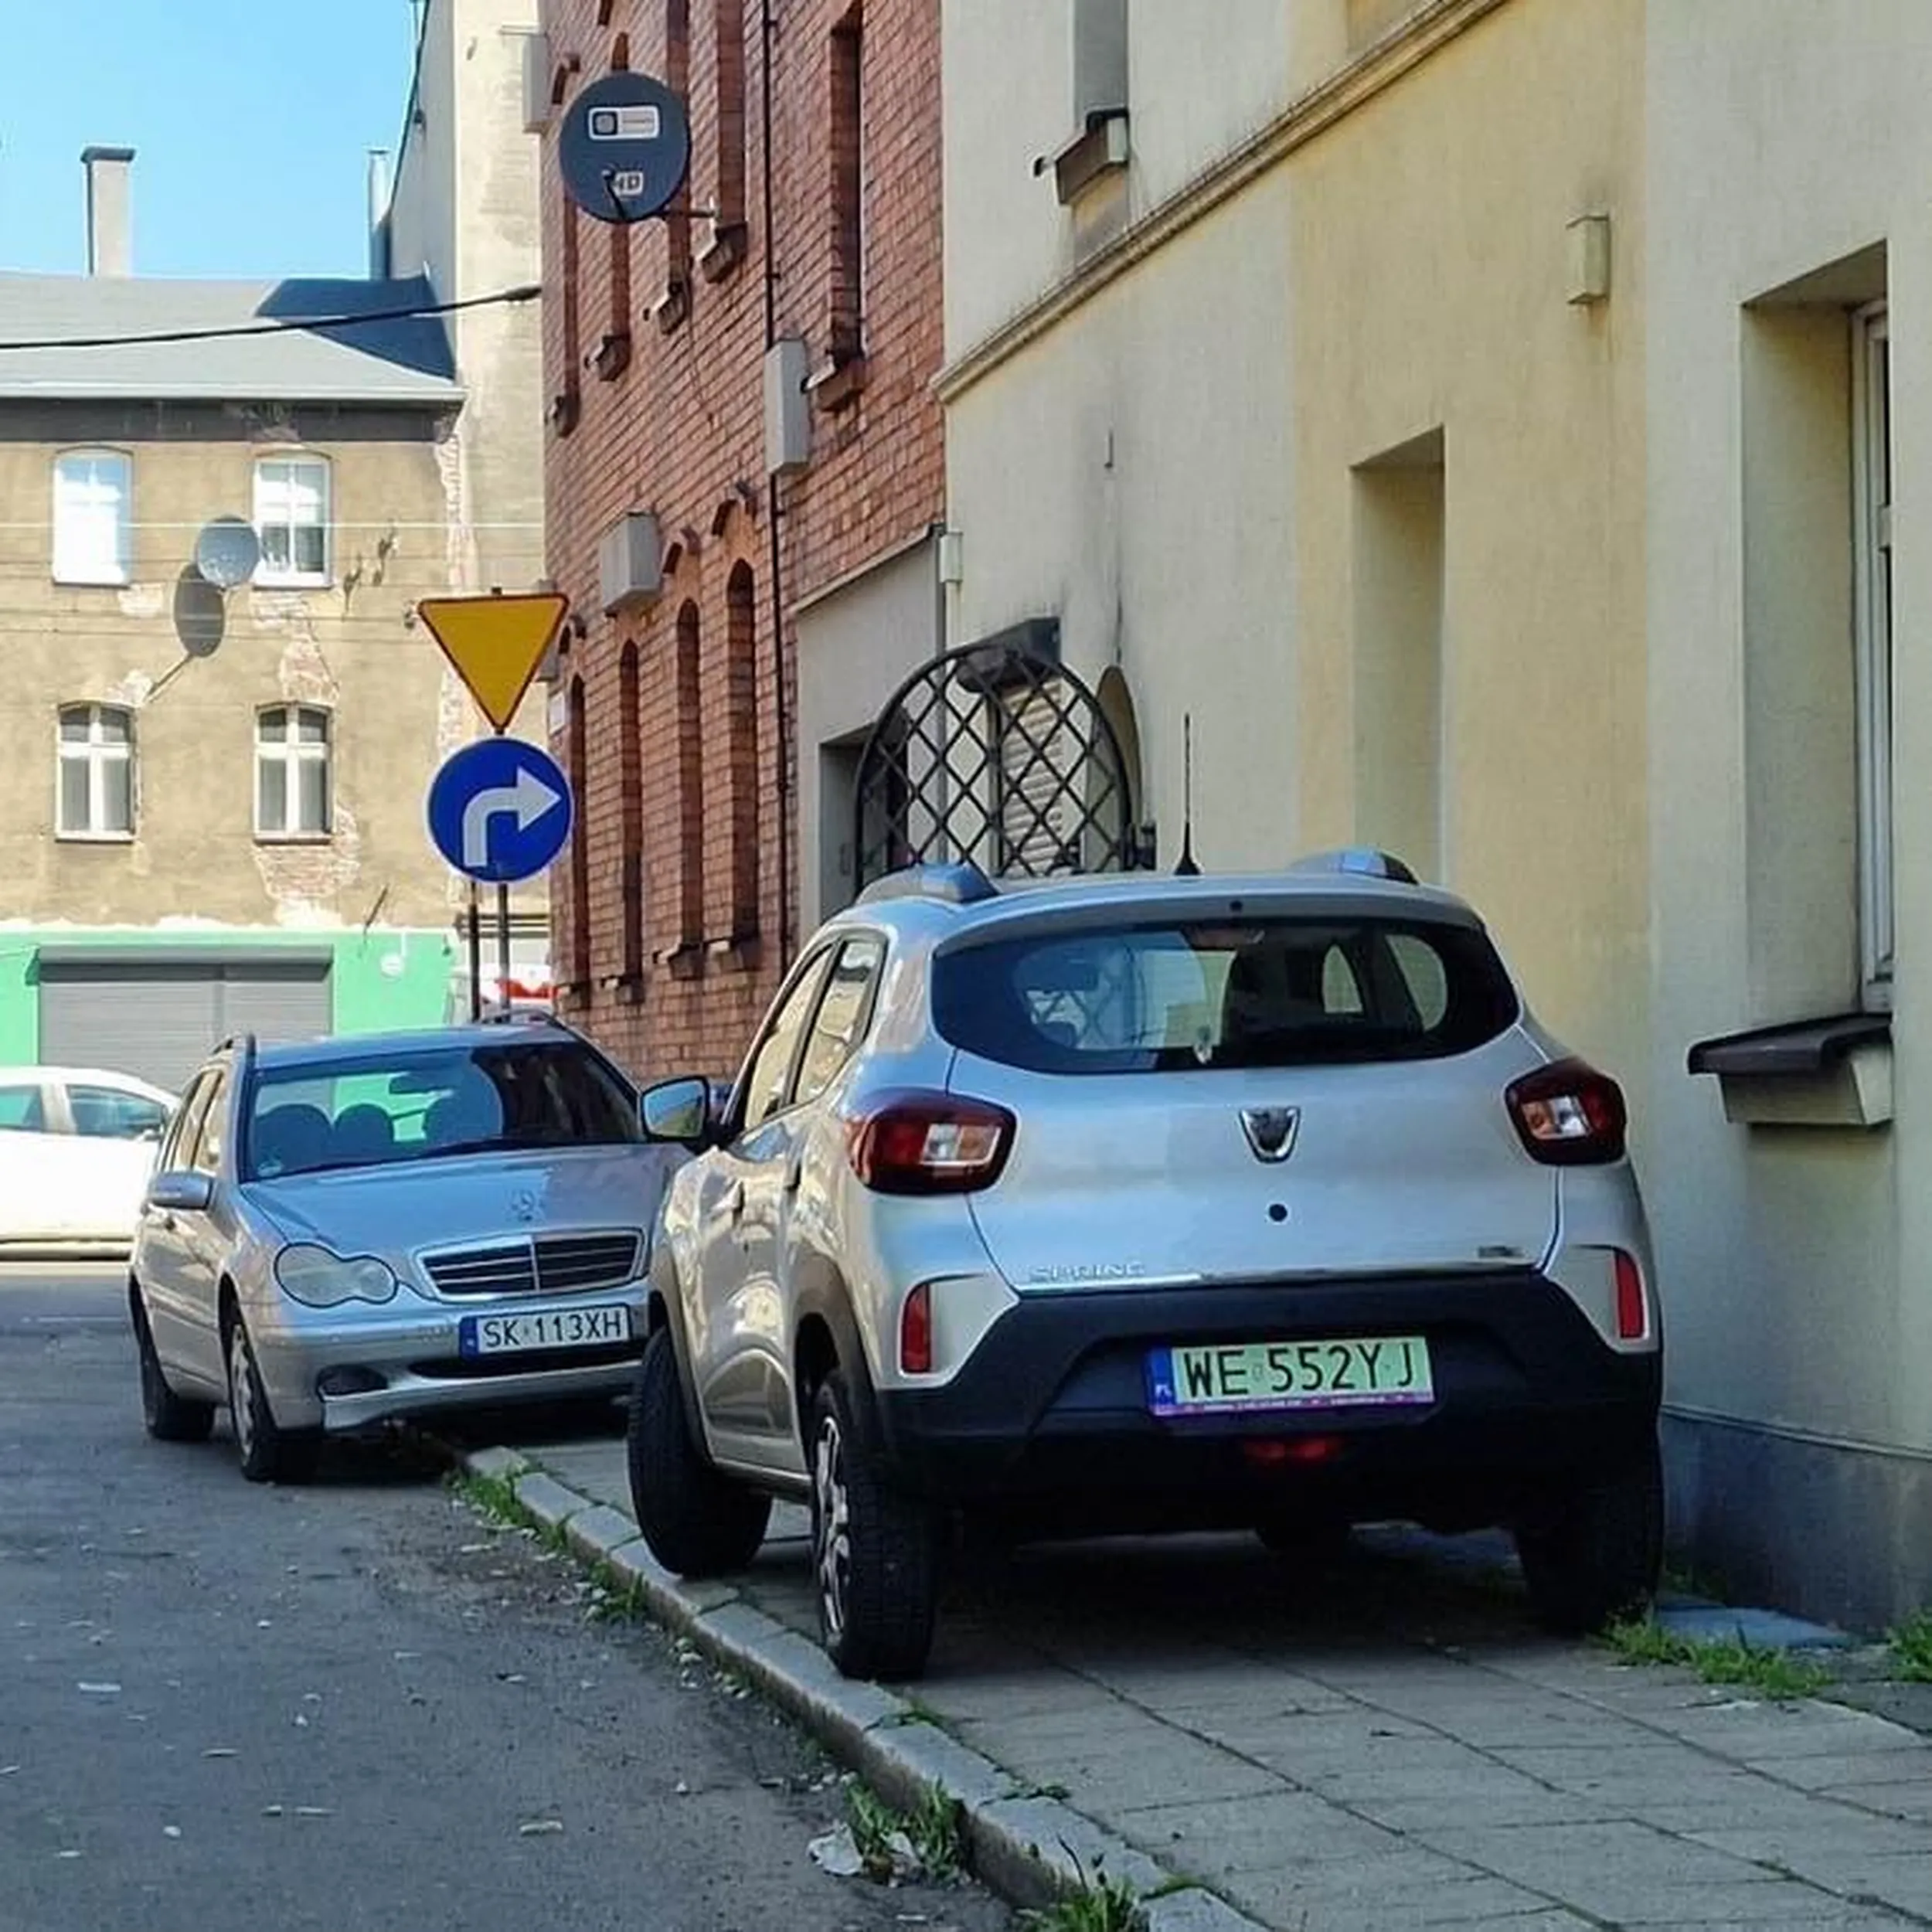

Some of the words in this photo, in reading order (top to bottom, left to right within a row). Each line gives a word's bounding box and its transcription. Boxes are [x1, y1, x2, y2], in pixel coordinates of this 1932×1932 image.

[483, 1319, 520, 1349] SK
[535, 1310, 621, 1343] 113XH
[1183, 1351, 1249, 1397] WE
[1267, 1342, 1414, 1391] 552YJ
